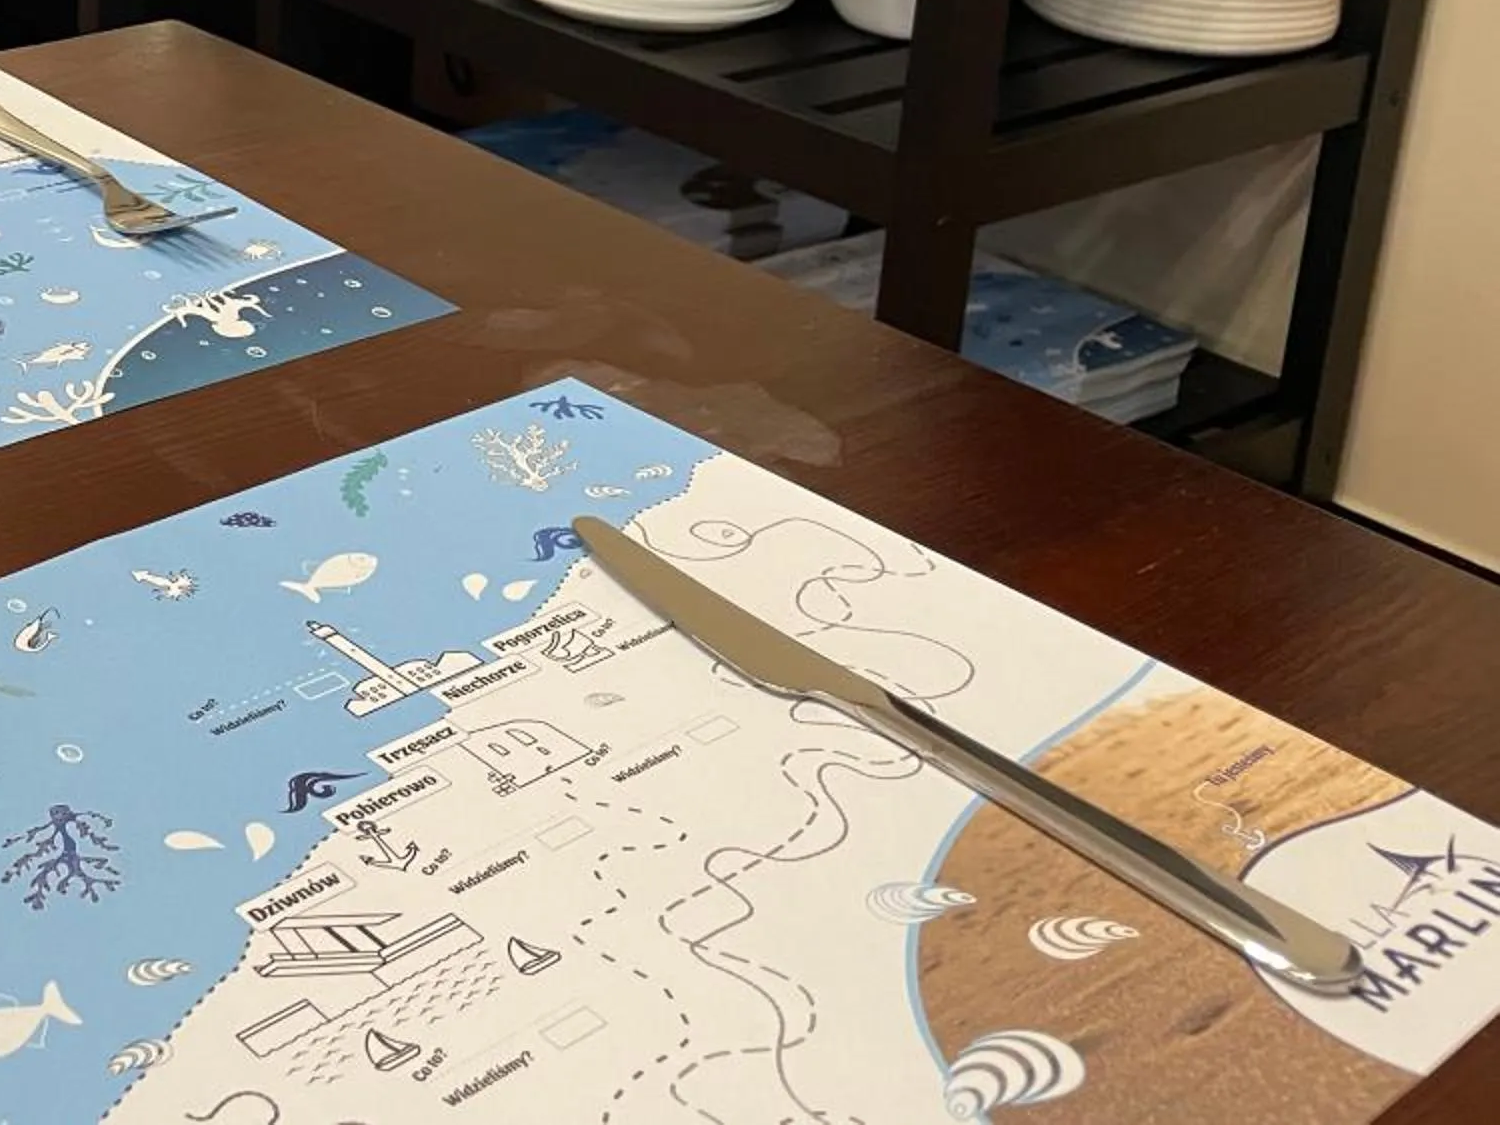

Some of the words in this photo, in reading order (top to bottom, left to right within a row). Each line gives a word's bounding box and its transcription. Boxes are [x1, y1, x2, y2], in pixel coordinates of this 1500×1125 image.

[492, 608, 588, 652] Pogorzelica
[441, 659, 529, 701] Niechorze
[377, 726, 457, 765] Trzęsacz
[335, 774, 438, 826] Pobierowo
[422, 863, 439, 876] Co
[247, 872, 341, 924] Dziwnów
[411, 1065, 433, 1082] Co
[426, 1046, 449, 1069] to?
